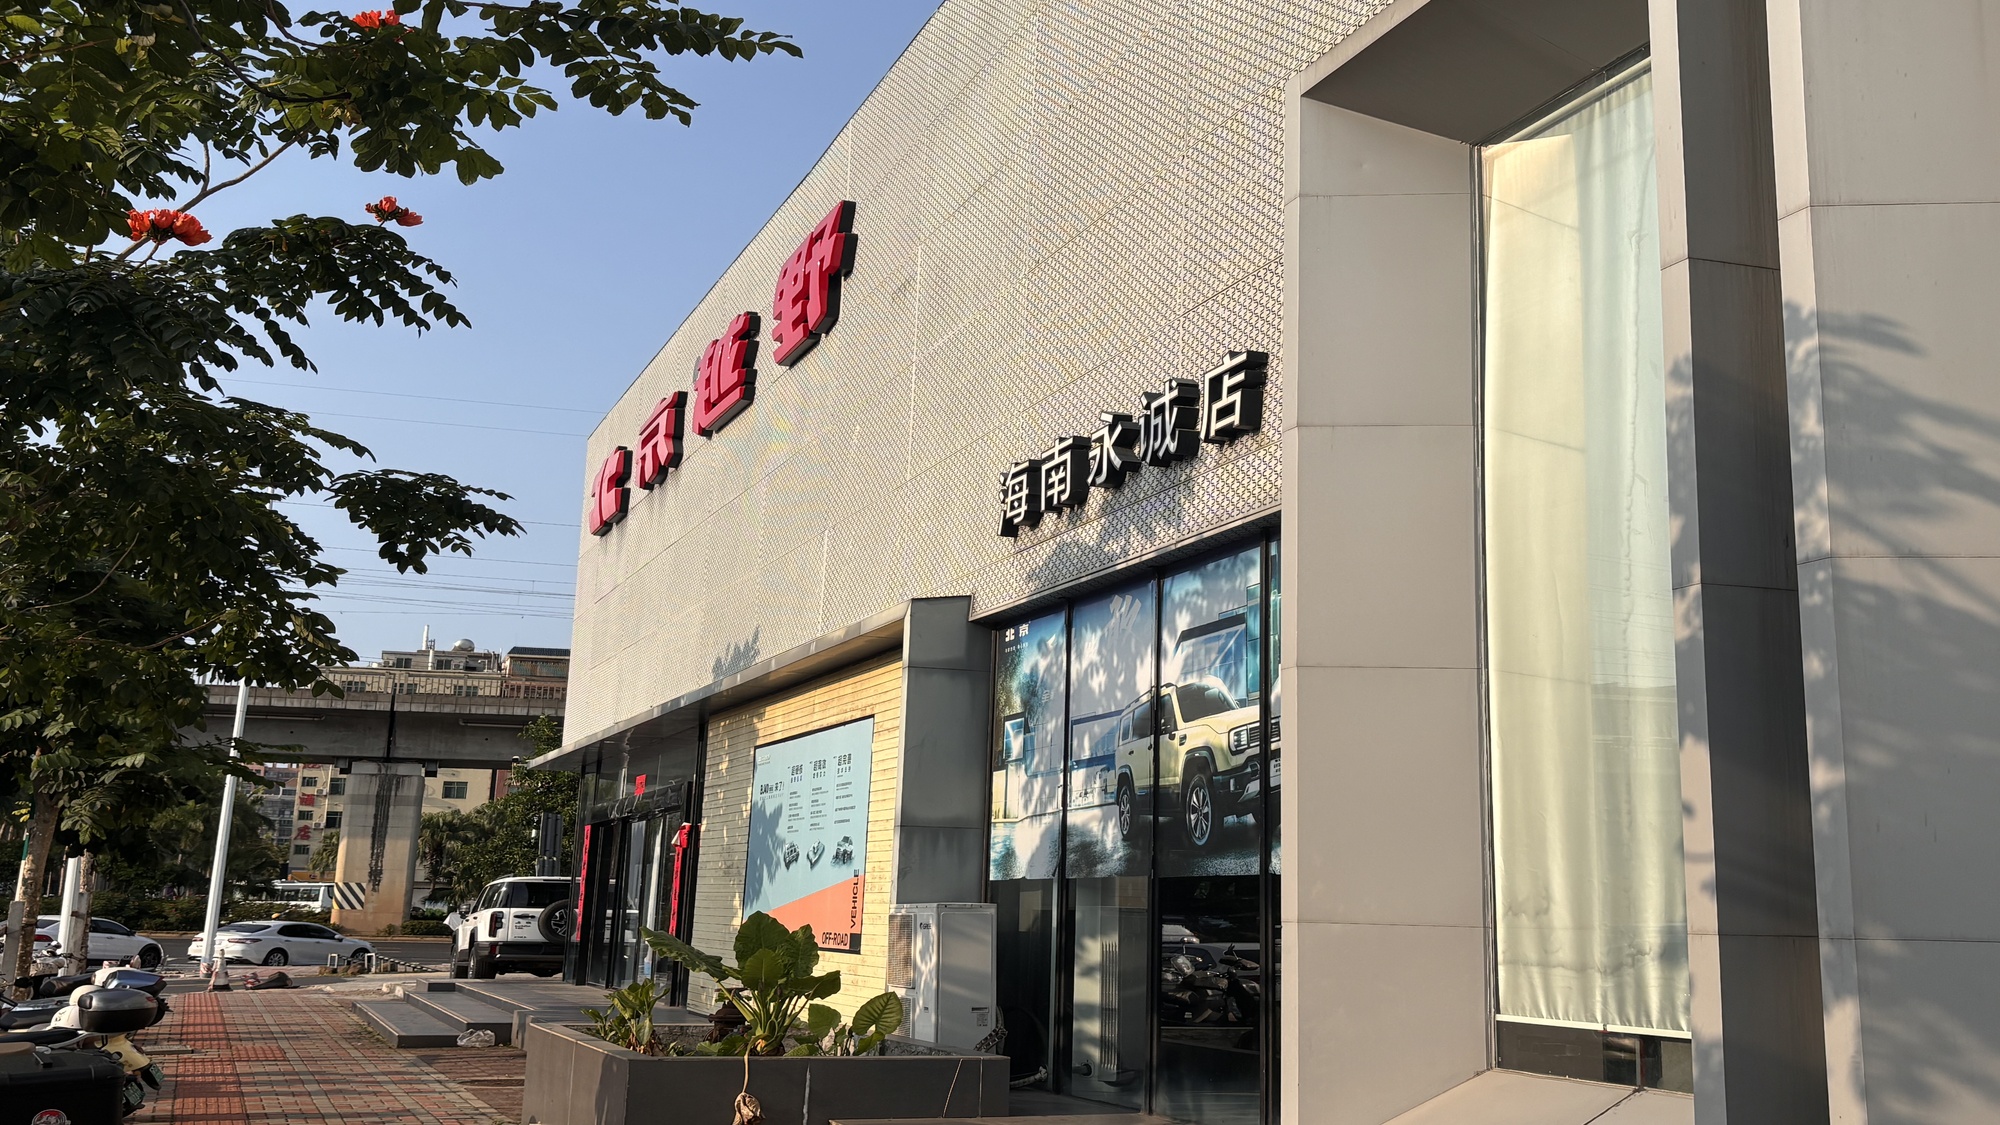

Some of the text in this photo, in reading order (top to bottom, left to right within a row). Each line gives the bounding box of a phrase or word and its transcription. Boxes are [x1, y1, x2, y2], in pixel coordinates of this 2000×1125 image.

[589, 201, 855, 536] 北京越野
[998, 351, 1264, 537] 海南永诚店
[1005, 623, 1030, 642] 北京
[850, 869, 860, 929] VEHICLE
[822, 932, 848, 946] OFF-ROAD
